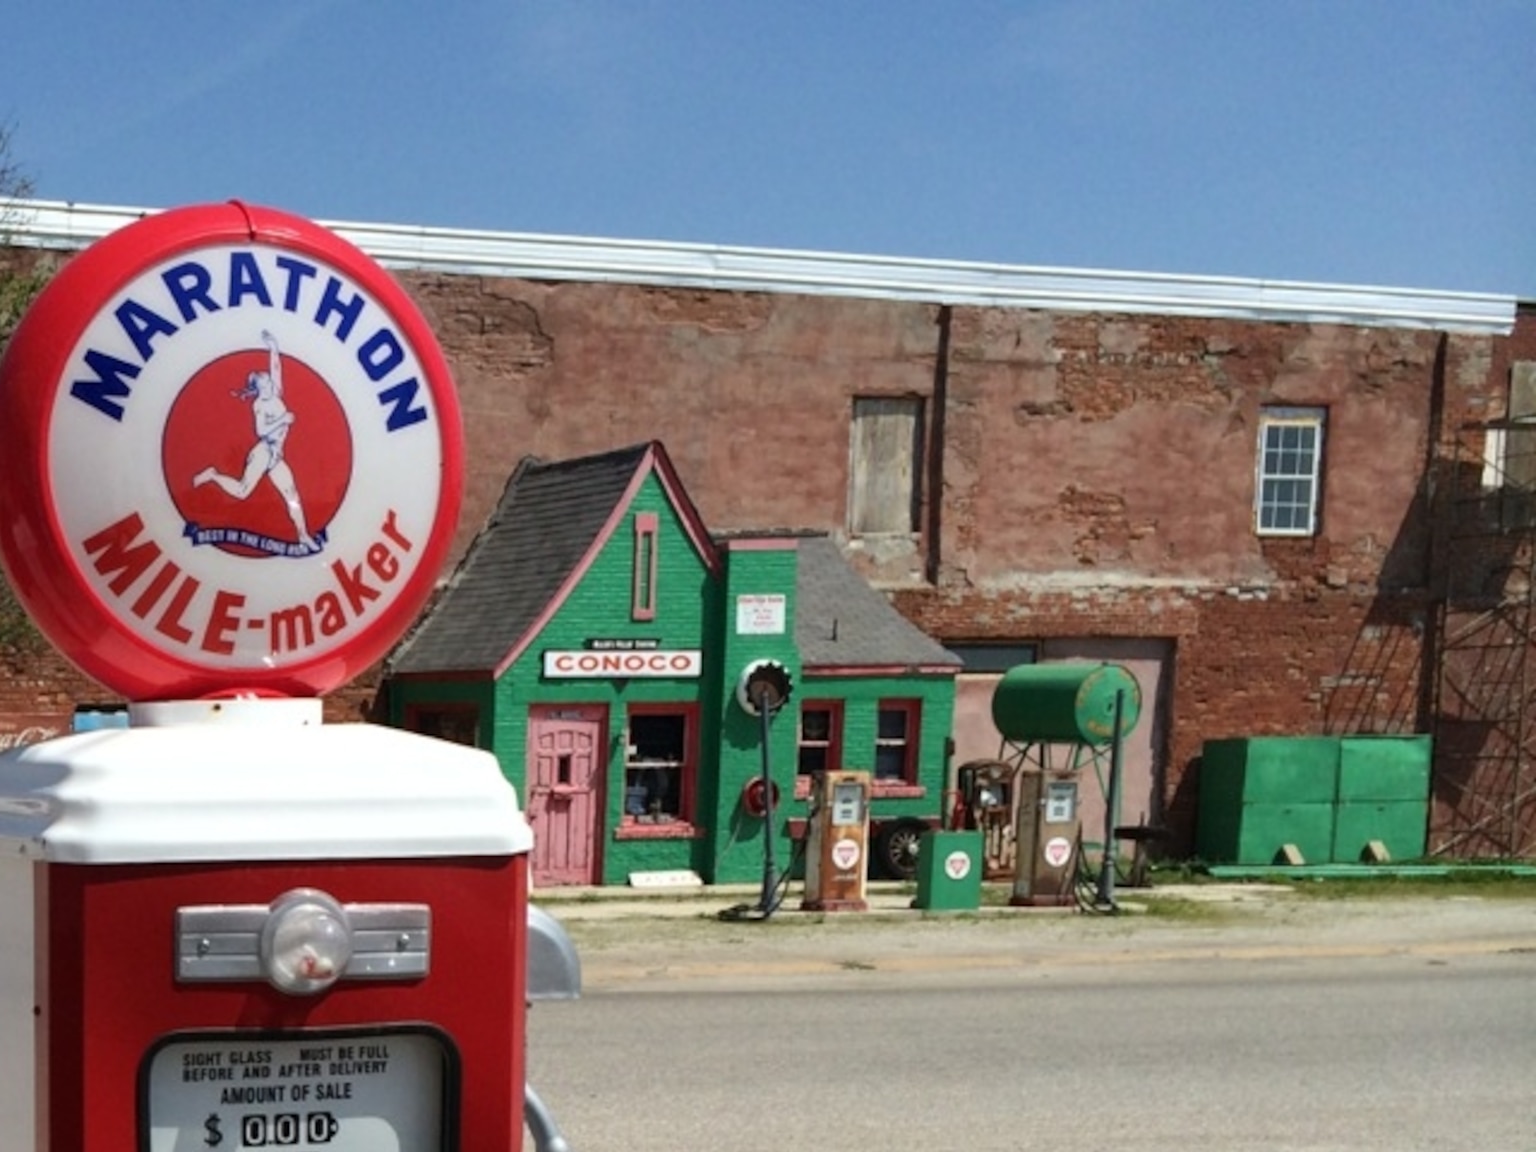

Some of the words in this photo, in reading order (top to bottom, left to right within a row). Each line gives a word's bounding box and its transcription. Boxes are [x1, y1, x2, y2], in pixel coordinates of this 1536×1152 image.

[70, 252, 428, 432] MARATHON
[82, 509, 413, 656] MILE-maker
[555, 655, 691, 671] CONOCO
[183, 1053, 221, 1066] SIGHT
[230, 1051, 272, 1064] GLASS
[300, 1048, 332, 1061] MUST
[338, 1048, 354, 1060] BE
[359, 1046, 389, 1059] FULL
[183, 1067, 233, 1082] BEFORE
[243, 1066, 271, 1079] AND
[278, 1064, 322, 1078] AFTER
[329, 1061, 387, 1076] DELIVERY
[221, 1086, 285, 1105] AMOUNT
[291, 1085, 310, 1101] OF
[316, 1083, 352, 1100] SALE
[204, 1113, 223, 1148] $
